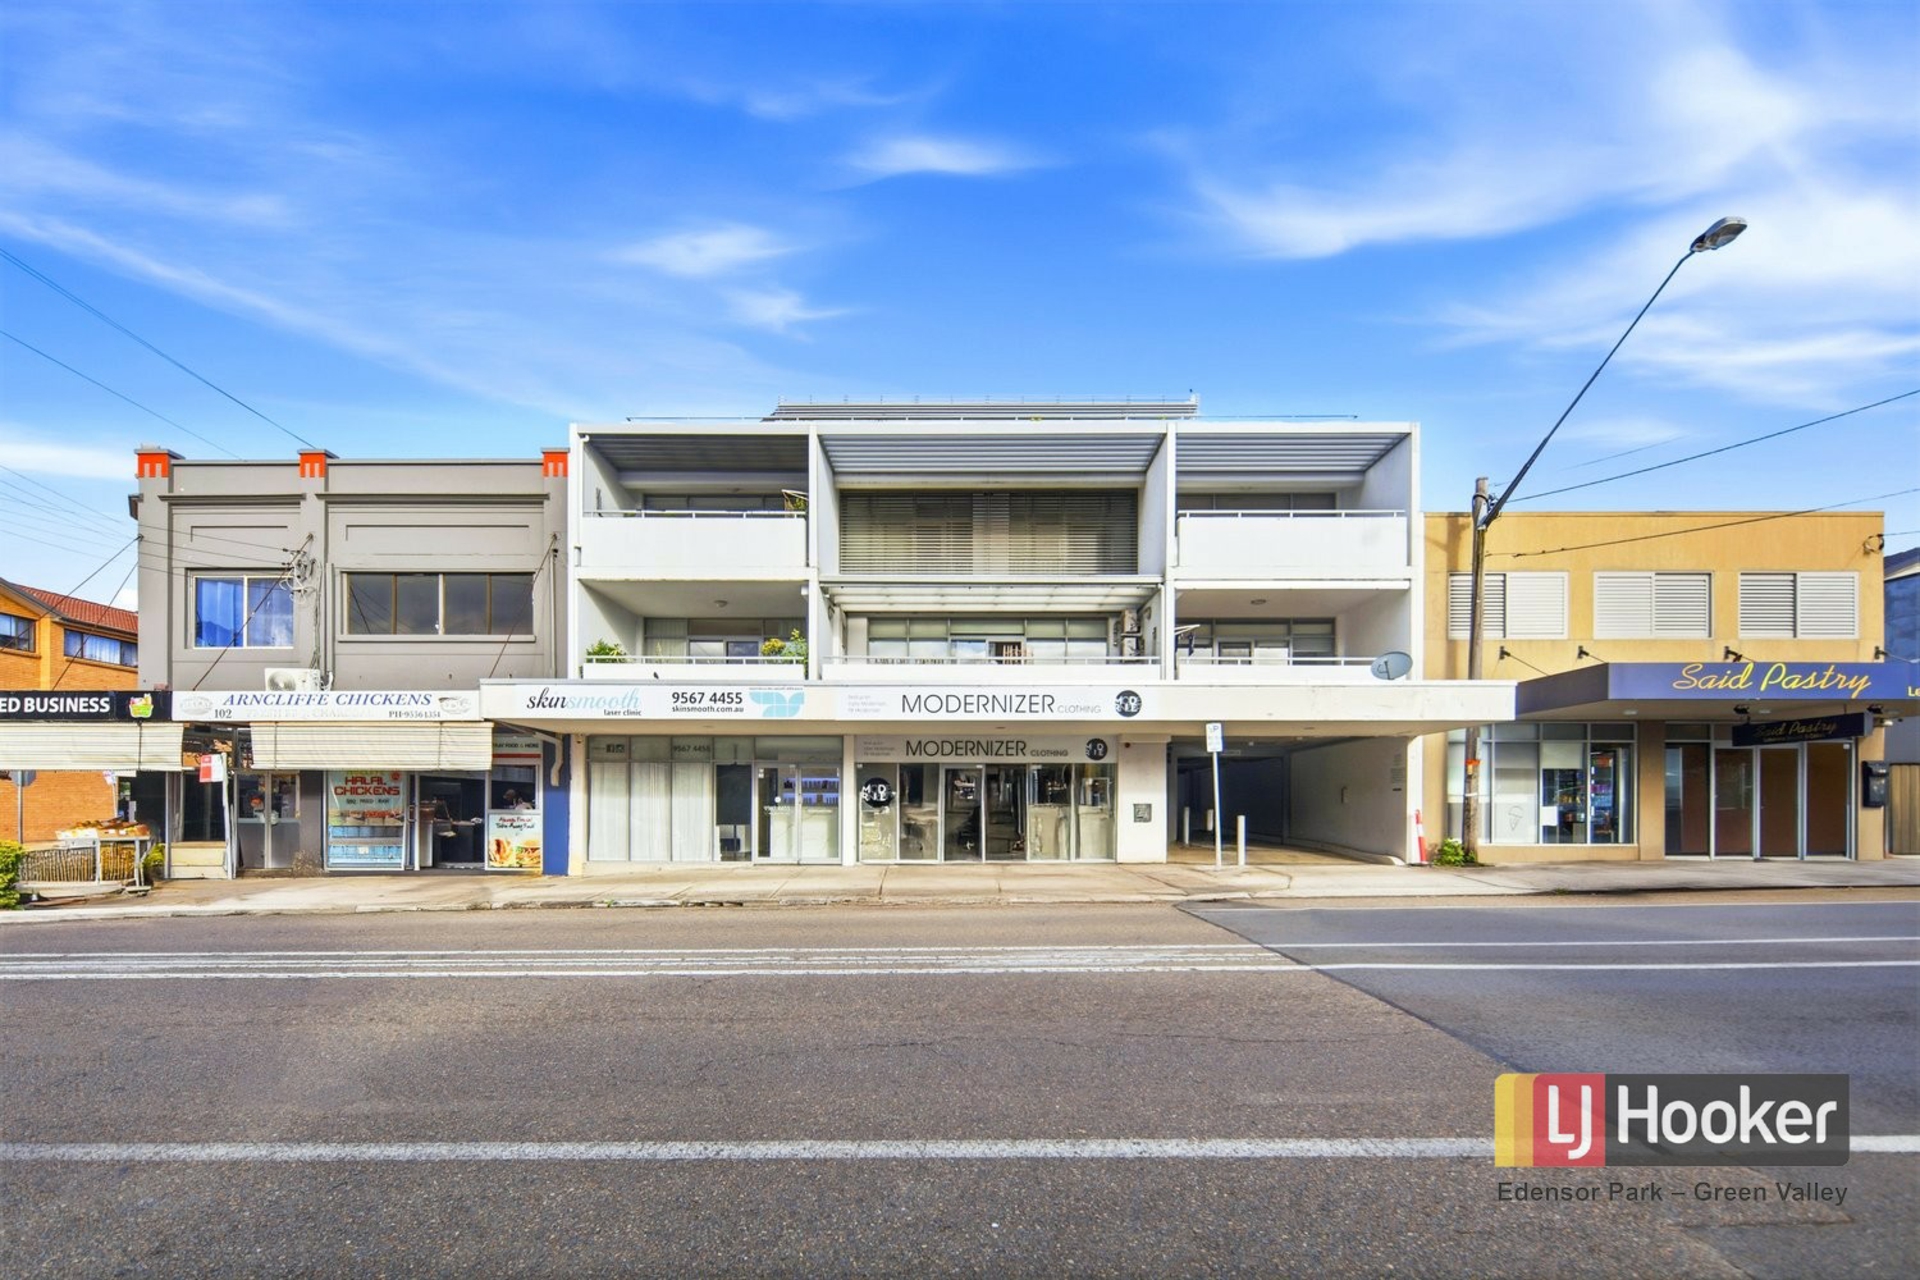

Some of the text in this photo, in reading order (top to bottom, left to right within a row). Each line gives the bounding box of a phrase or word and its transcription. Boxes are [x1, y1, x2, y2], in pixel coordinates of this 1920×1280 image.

[1672, 662, 1872, 699] Said Pastry
[0, 697, 110, 713] ED BUSINESS
[223, 693, 331, 706] ARNCLIFFE
[336, 693, 433, 706] CHICKENS
[671, 692, 743, 705] 9567 4455
[901, 694, 1055, 714] MODERNIZER
[1057, 704, 1101, 714] CLOTHING
[214, 708, 232, 719] 102
[671, 705, 744, 713] skinsmooth.com.au
[905, 740, 1027, 757] MODERNIZER
[345, 776, 387, 785] HALAL
[334, 786, 400, 796] CHICKENS
